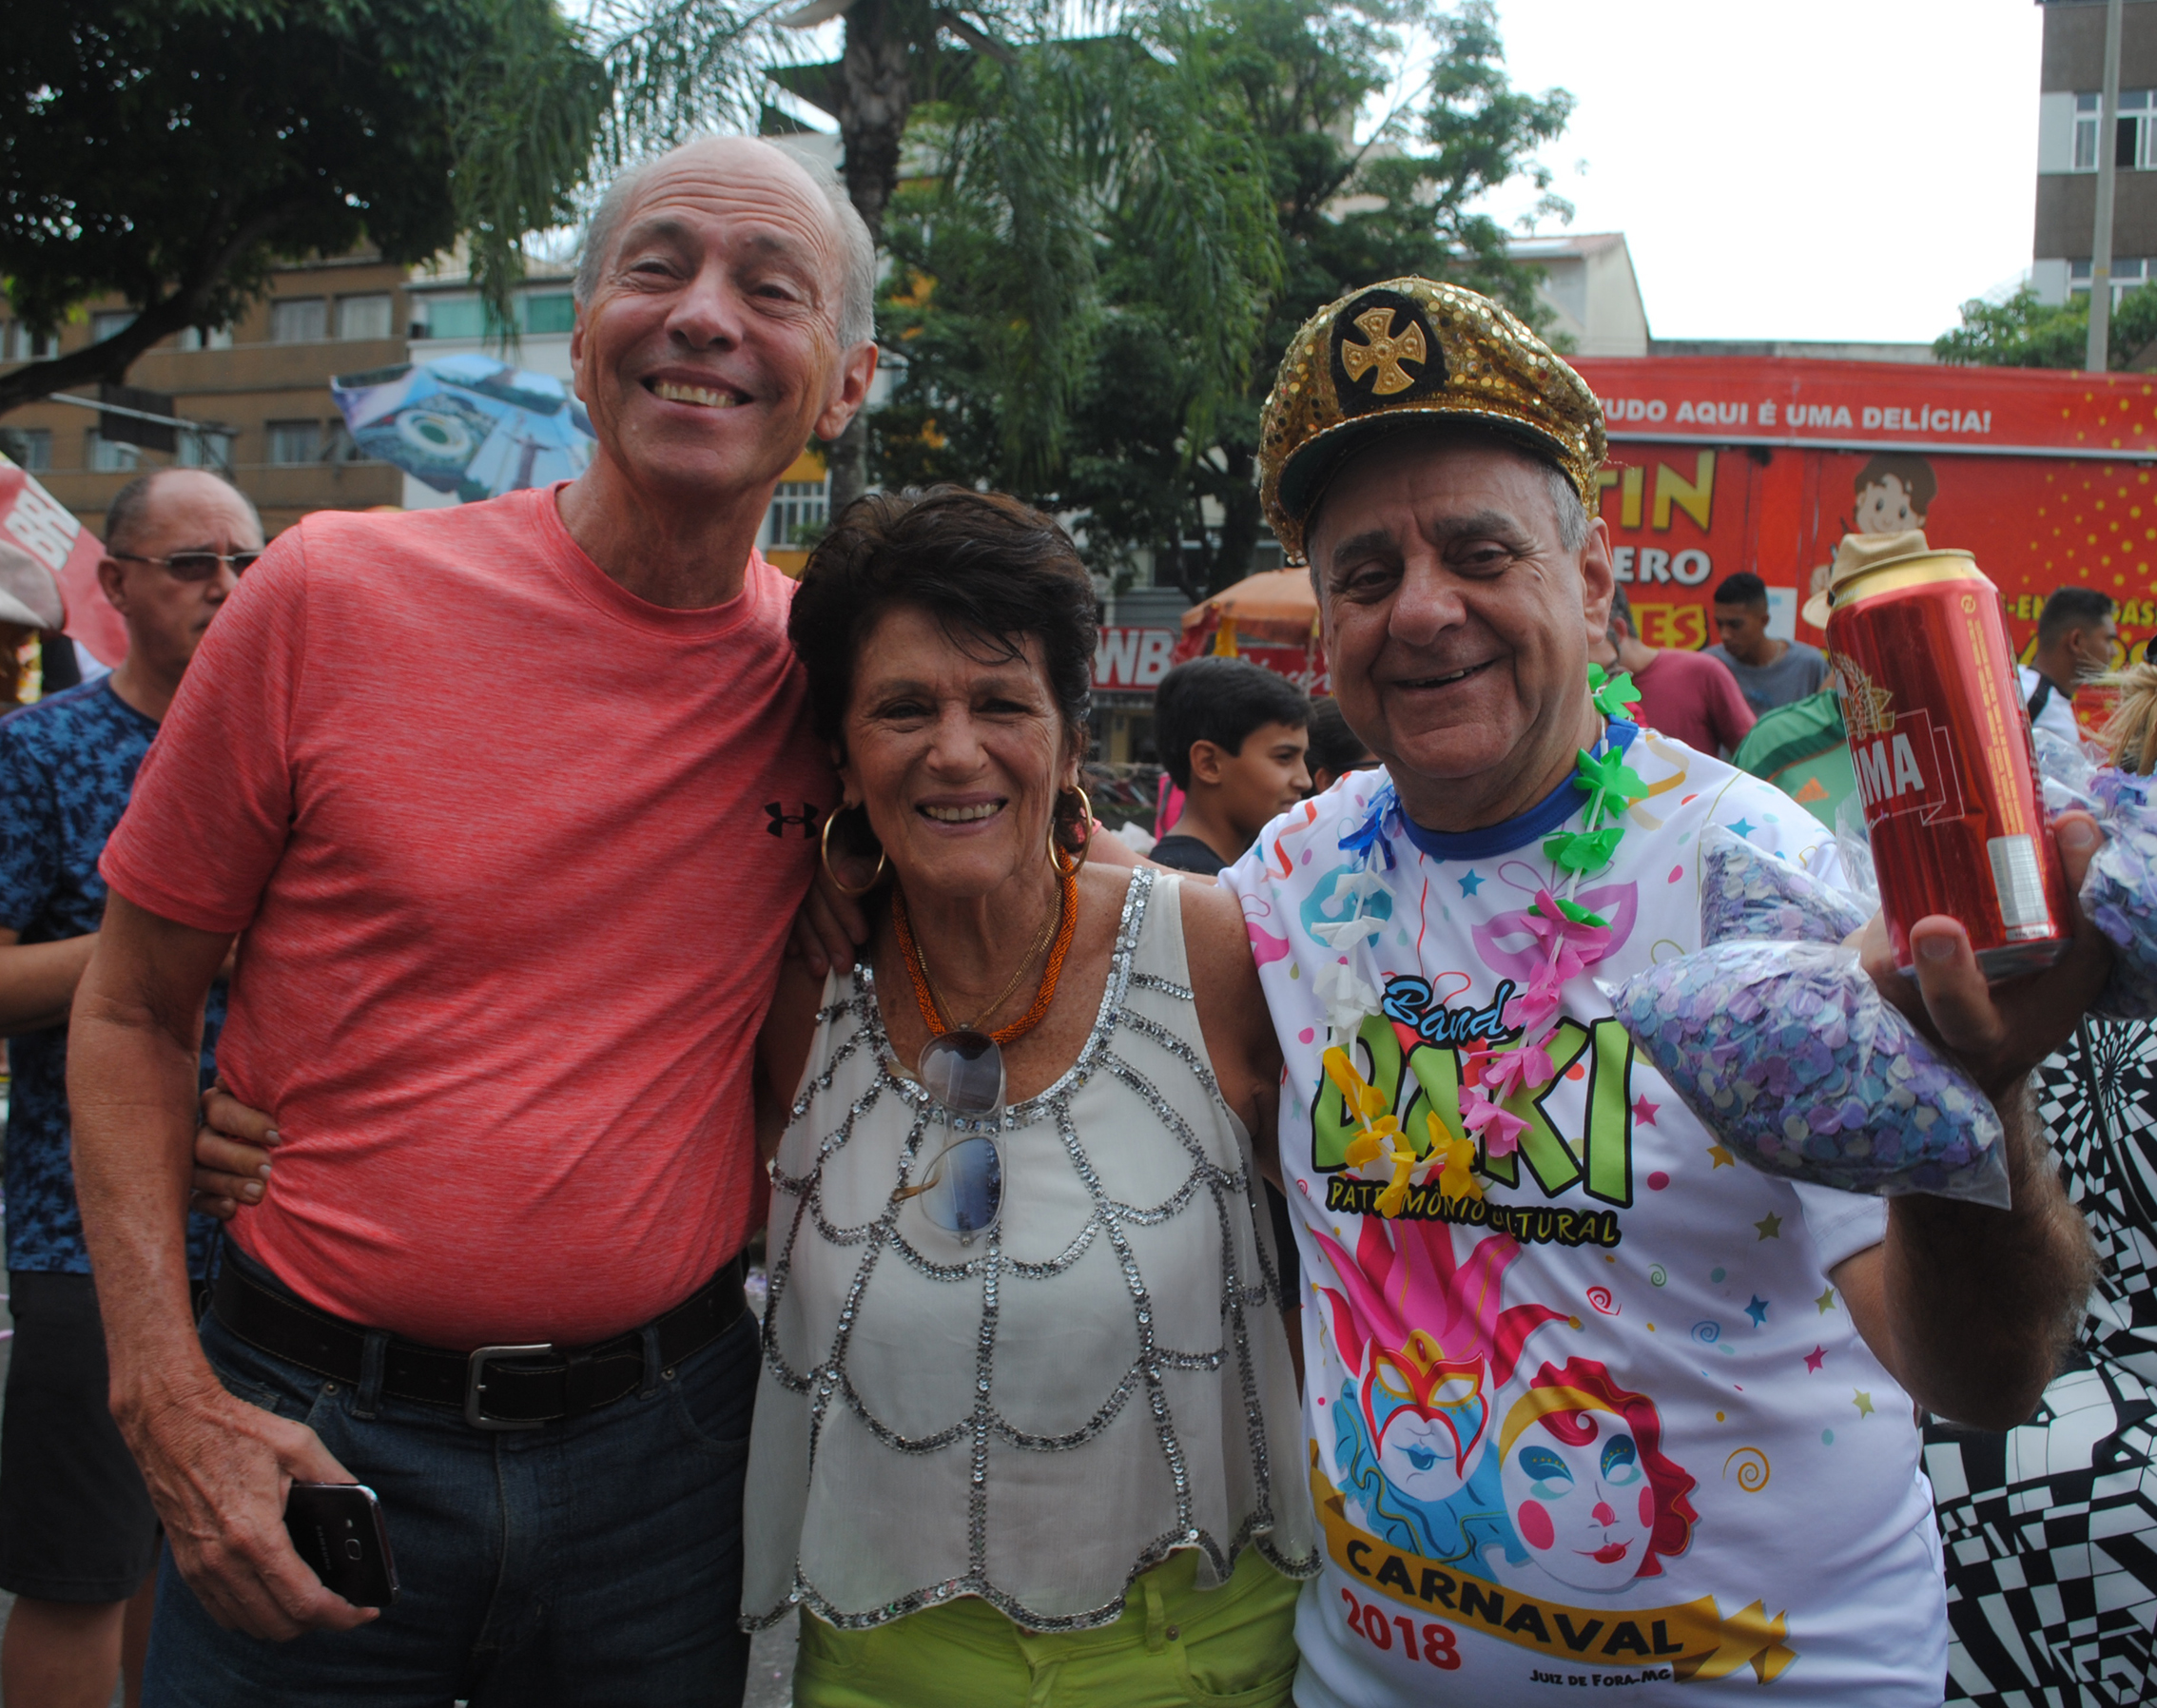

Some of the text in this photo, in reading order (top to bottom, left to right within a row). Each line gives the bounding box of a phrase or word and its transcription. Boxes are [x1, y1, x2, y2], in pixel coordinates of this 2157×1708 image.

[1675, 400, 1748, 425] AQUI
[1759, 398, 1777, 426] É
[1786, 405, 1854, 428] UMA
[1861, 404, 1992, 433] DELÍCIA!
[1346, 1539, 1683, 1657] CARNAVAL
[1340, 1587, 1462, 1671] 2018
[1529, 1669, 1564, 1685] JUIZ
